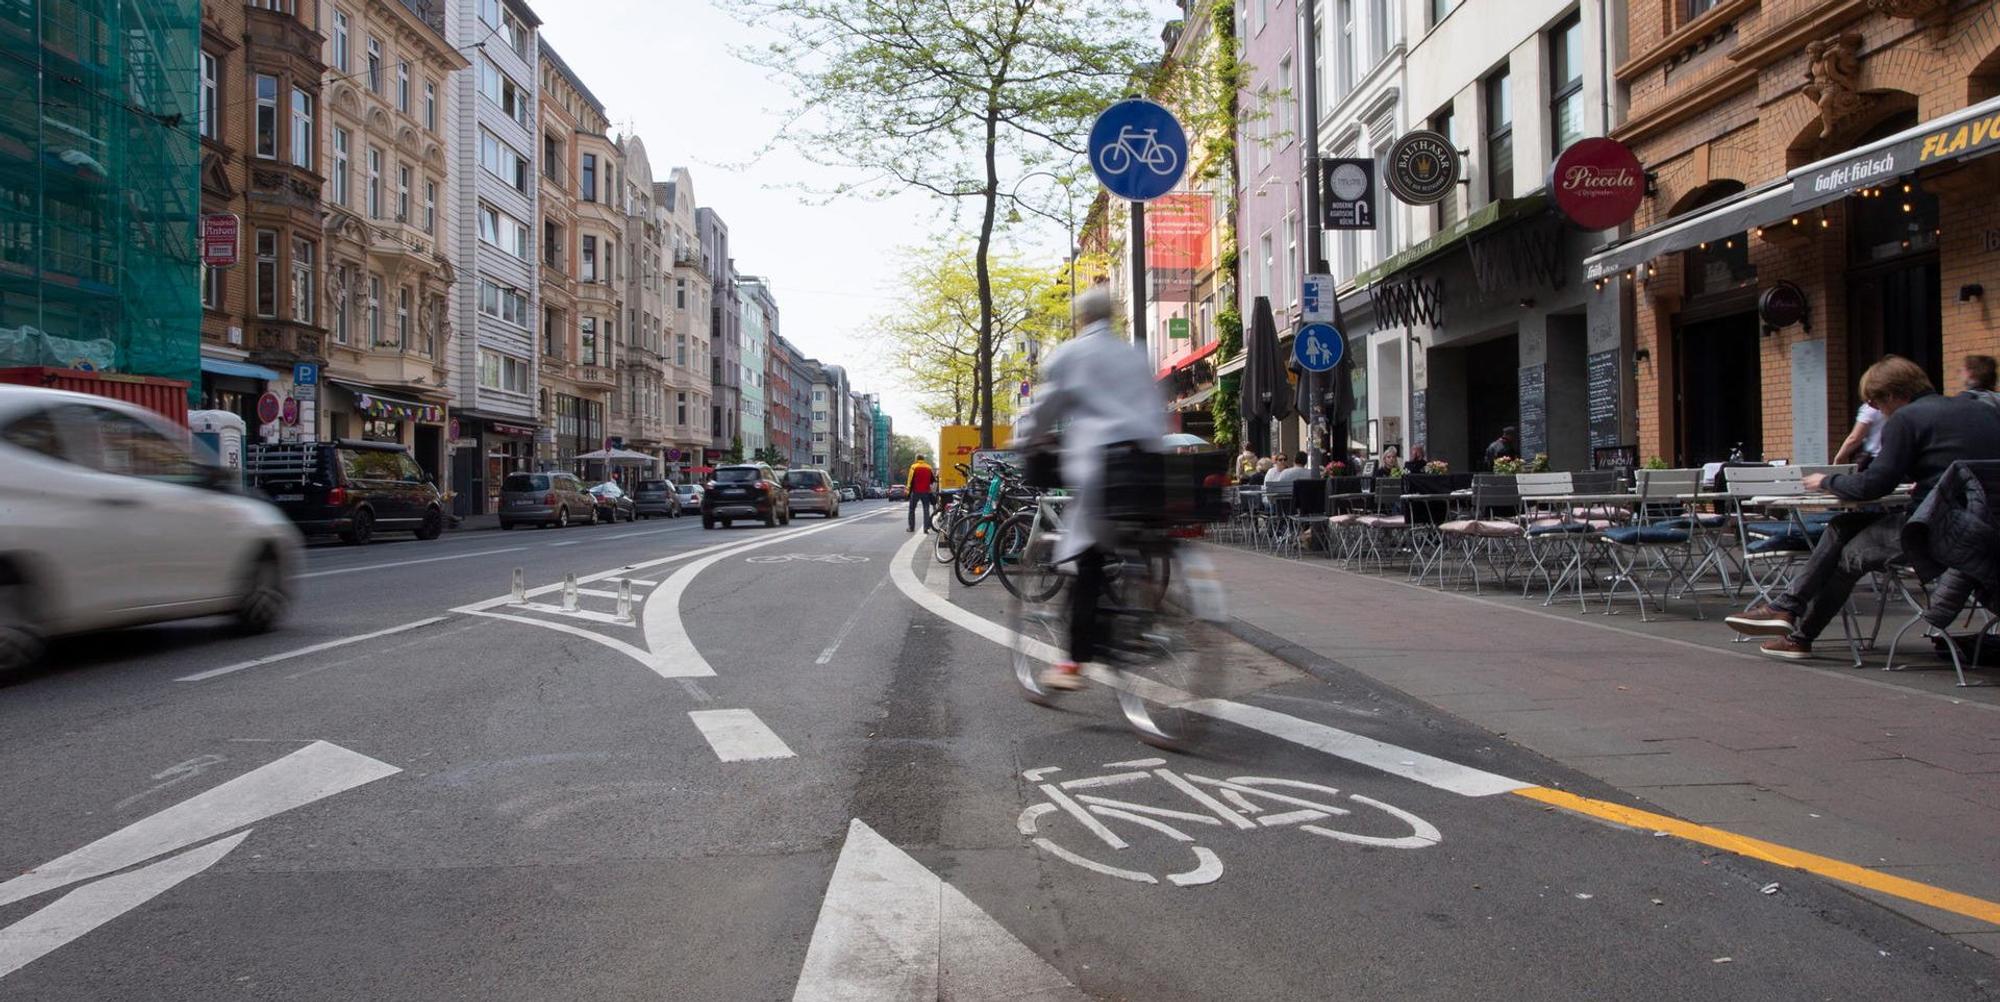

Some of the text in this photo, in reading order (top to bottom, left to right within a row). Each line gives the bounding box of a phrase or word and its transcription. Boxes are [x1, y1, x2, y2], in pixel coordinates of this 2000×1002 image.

[1399, 141, 1449, 168] BALTHASAR
[1563, 165, 1635, 190] Piccola
[299, 366, 312, 381] P
